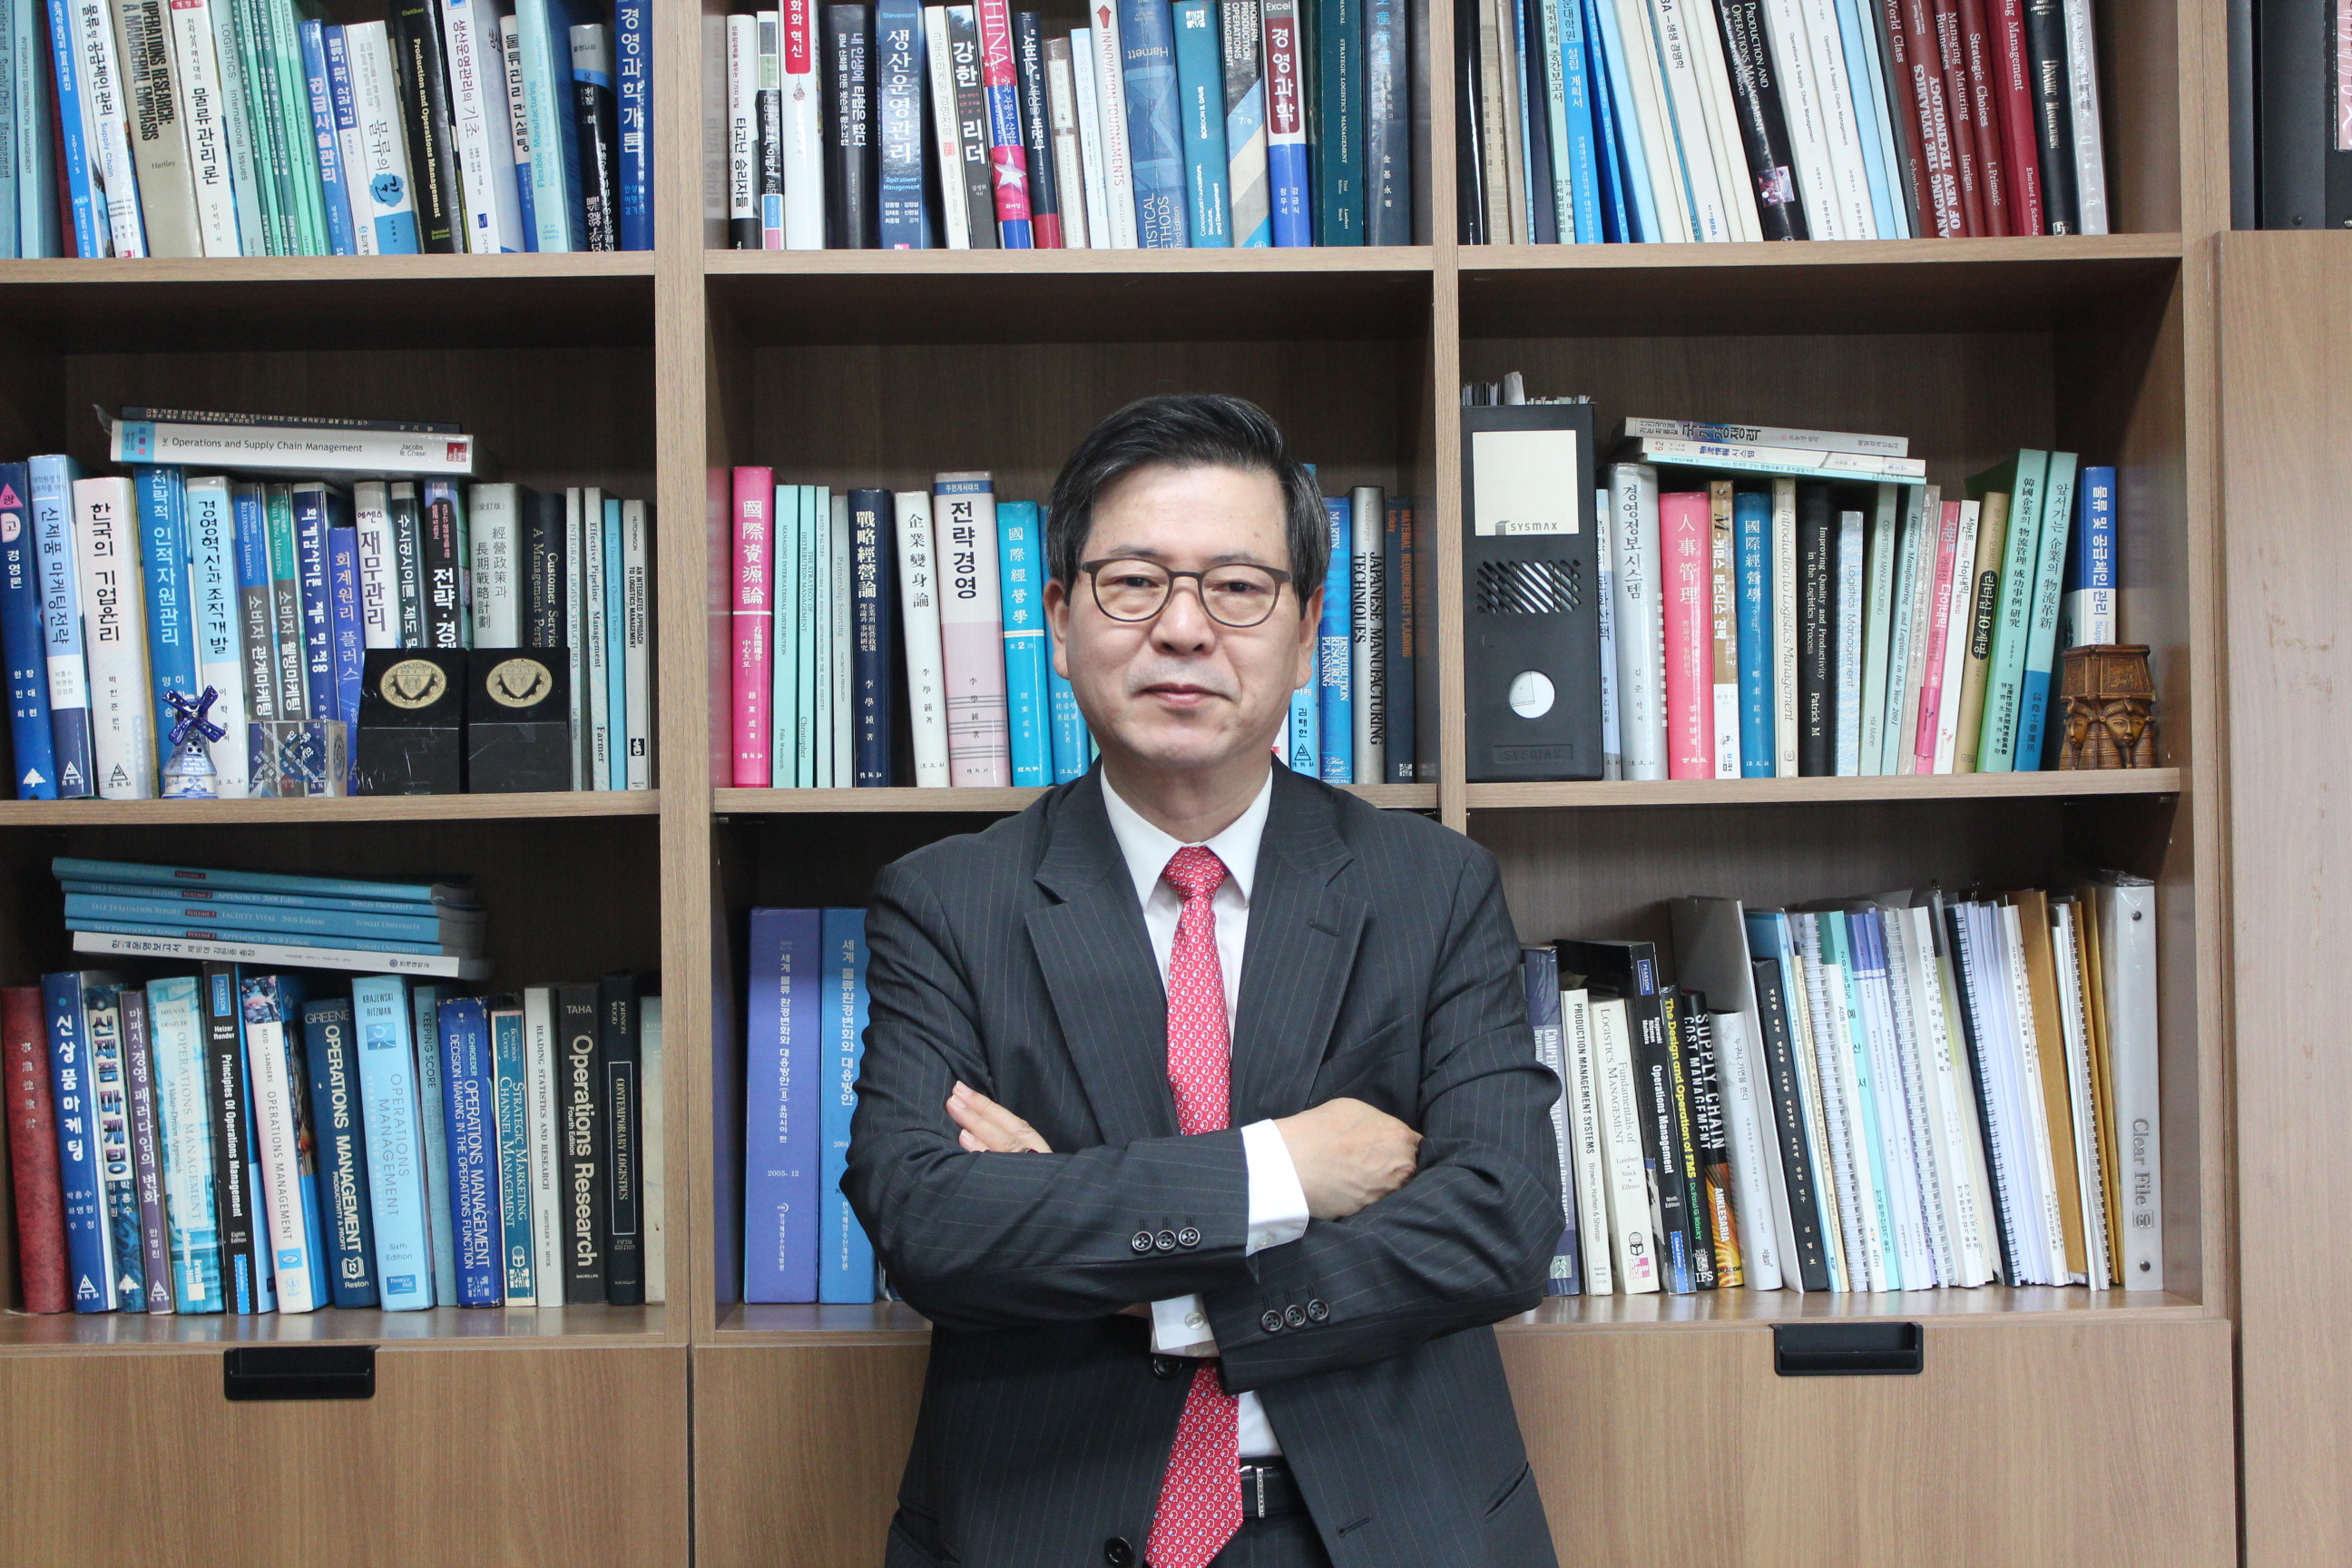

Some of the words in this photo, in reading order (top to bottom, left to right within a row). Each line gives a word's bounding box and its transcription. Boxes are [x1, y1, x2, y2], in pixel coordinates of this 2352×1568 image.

[83, 5, 100, 29] 물류
[142, 1, 167, 65] OPERATIONS
[882, 12, 916, 20] Stevenson
[1232, 2, 1241, 59] OPERATIONS
[1241, 2, 1250, 61] PRODUCTION
[1250, 1, 1258, 42] MODERN
[1266, 1, 1291, 11] Excel
[1731, 4, 1745, 63] OPERATIONS
[125, 15, 151, 83] MANAGERIAL
[790, 31, 802, 58] 혁신
[1127, 46, 1169, 60] Harnett
[1223, 3, 1233, 67] MANAGEMENT
[1744, 2, 1763, 65] PRODUCTION
[1759, 67, 1769, 88] AND
[1936, 13, 1950, 71] Businesses
[2008, 22, 2024, 92] Management
[88, 42, 110, 90] 공급체인
[414, 38, 426, 89] Production
[453, 19, 473, 103] 생산운영관리의
[464, 105, 480, 139] 기초
[953, 41, 977, 88] 강한
[1102, 31, 1118, 102] INNOVATION
[1272, 28, 1295, 122] 경영과학
[1948, 12, 1962, 65] Managing
[1955, 71, 1968, 121] Maturing
[1969, 33, 1982, 83] Strategic
[1976, 85, 1988, 127] Choices
[95, 92, 113, 116] 관리
[135, 87, 160, 142] EMPHASIS
[152, 68, 174, 126] RESEARCH:
[220, 24, 236, 81] LOGISTICS:
[230, 89, 243, 146] International
[239, 151, 249, 181] Issues
[419, 89, 430, 107] and
[887, 29, 912, 164] 생산운영관리
[1240, 116, 1253, 125] 7/e
[191, 87, 220, 186] 물류관리론
[421, 108, 435, 158] Operations
[735, 117, 749, 156] 타고난
[963, 119, 985, 165] 리더
[1108, 103, 1125, 186] TOURNAMENTS
[152, 160, 176, 170] Hartley
[427, 159, 441, 219] Management
[735, 161, 750, 209] 승리자들
[884, 183, 920, 191] Management
[1962, 154, 1973, 192] Harrigan
[172, 437, 221, 450] Operations
[224, 439, 242, 449] and
[244, 439, 274, 451] Supply
[277, 441, 303, 450] Chain
[305, 443, 363, 454] Management
[357, 510, 383, 523] 에센스
[2092, 485, 2108, 511] 물류
[2093, 516, 2107, 529] 및
[42, 506, 62, 557] 신제품
[741, 500, 765, 605] 國際資源論
[950, 500, 977, 601] 전략경영
[1330, 511, 1339, 549] MARTIN
[1510, 522, 1558, 532] SYSMAX
[1622, 484, 1642, 600] 경영정보시스템
[1781, 510, 1791, 578] Introduction
[7, 550, 22, 589] 경영론
[155, 527, 179, 646] 인적자원관리
[335, 552, 355, 622] 회계원리
[361, 531, 387, 633] 재무관리
[1008, 526, 1028, 624] 國際經營學
[1369, 552, 1383, 621] JAPANESE
[1678, 514, 1698, 605] 人事管理
[1744, 519, 1762, 601] 國際經營學
[1849, 564, 1857, 609] Logistics
[2092, 534, 2108, 586] 공급체인
[48, 562, 69, 644] 마케팅전략
[1354, 552, 1367, 644] TECHNIQUES
[1780, 593, 1793, 646] Logistics
[2093, 591, 2108, 615] 관리
[339, 629, 359, 681] 플러스
[1322, 636, 1330, 687] PLANNING
[1331, 636, 1339, 686] RESOURCE
[1339, 636, 1348, 701] DISTRIBUTION
[1846, 612, 1856, 688] Management
[1370, 627, 1383, 746] MANUFACTURING
[1781, 648, 1794, 720] Management
[363, 994, 394, 1004] KRAJEWSKI
[1642, 965, 1650, 993] PEARSON
[214, 1025, 233, 1034] Heizer
[305, 1010, 350, 1024] GREENE
[367, 1006, 392, 1016] RITZMAN
[422, 1012, 433, 1054] KEEPING
[566, 1005, 593, 1014] TAHA
[1574, 1004, 1586, 1054] PRODUCTION
[1664, 998, 1674, 1020] The
[1684, 1017, 1698, 1050] COST
[264, 1054, 273, 1083] SANDERS
[468, 1033, 477, 1077] SCHROEDER
[1668, 1022, 1679, 1060] Design
[56, 1015, 83, 1162] 신상품마케팅
[222, 1054, 232, 1099] Principles
[325, 1025, 348, 1129] OPERATIONS
[425, 1055, 436, 1089] SCORE
[572, 1034, 595, 1158] Operations
[841, 1056, 854, 1106] 대응방안
[1579, 1055, 1592, 1116] MANAGEMENT
[1600, 1008, 1614, 1065] LOGISTICS
[1608, 1067, 1623, 1145] MANAGEMENT
[1673, 1062, 1683, 1083] and
[1695, 1014, 1717, 1083] SUPPLY
[1706, 1093, 1726, 1149] CHAIN
[225, 1100, 235, 1112] Of
[389, 1073, 409, 1176] OPERATIONS
[465, 1079, 483, 1166] OPERATIONS
[499, 1077, 511, 1138] CHANNEL
[514, 1082, 525, 1148] STRATEGIC
[1651, 1065, 1665, 1113] Operations
[1659, 1116, 1674, 1174] Management
[1675, 1085, 1690, 1142] Operation
[1690, 1058, 1710, 1150] MANAGEMENT
[226, 1113, 237, 1161] Operations
[377, 1098, 398, 1218] MANAGEMENT
[1583, 1116, 1596, 1154] SYSTEMS
[2132, 1119, 2149, 1168] Clear
[230, 1162, 243, 1217] Management
[267, 1092, 283, 1159] OPERATIONS
[276, 1163, 292, 1240] MANAGEMENT
[336, 1134, 362, 1253] MANAGEMENT
[501, 1140, 515, 1228] MANAGEMENT
[515, 1149, 527, 1220] MARKETING
[1685, 1157, 1696, 1178] FMS
[2134, 1171, 2151, 1206] File
[471, 1169, 489, 1268] MANAGEMENT
[574, 1161, 597, 1267] Research
[1714, 1187, 1730, 1242] ANKLESARIA
[345, 1279, 369, 1289] Reston
[1695, 1271, 1714, 1282] IFS
